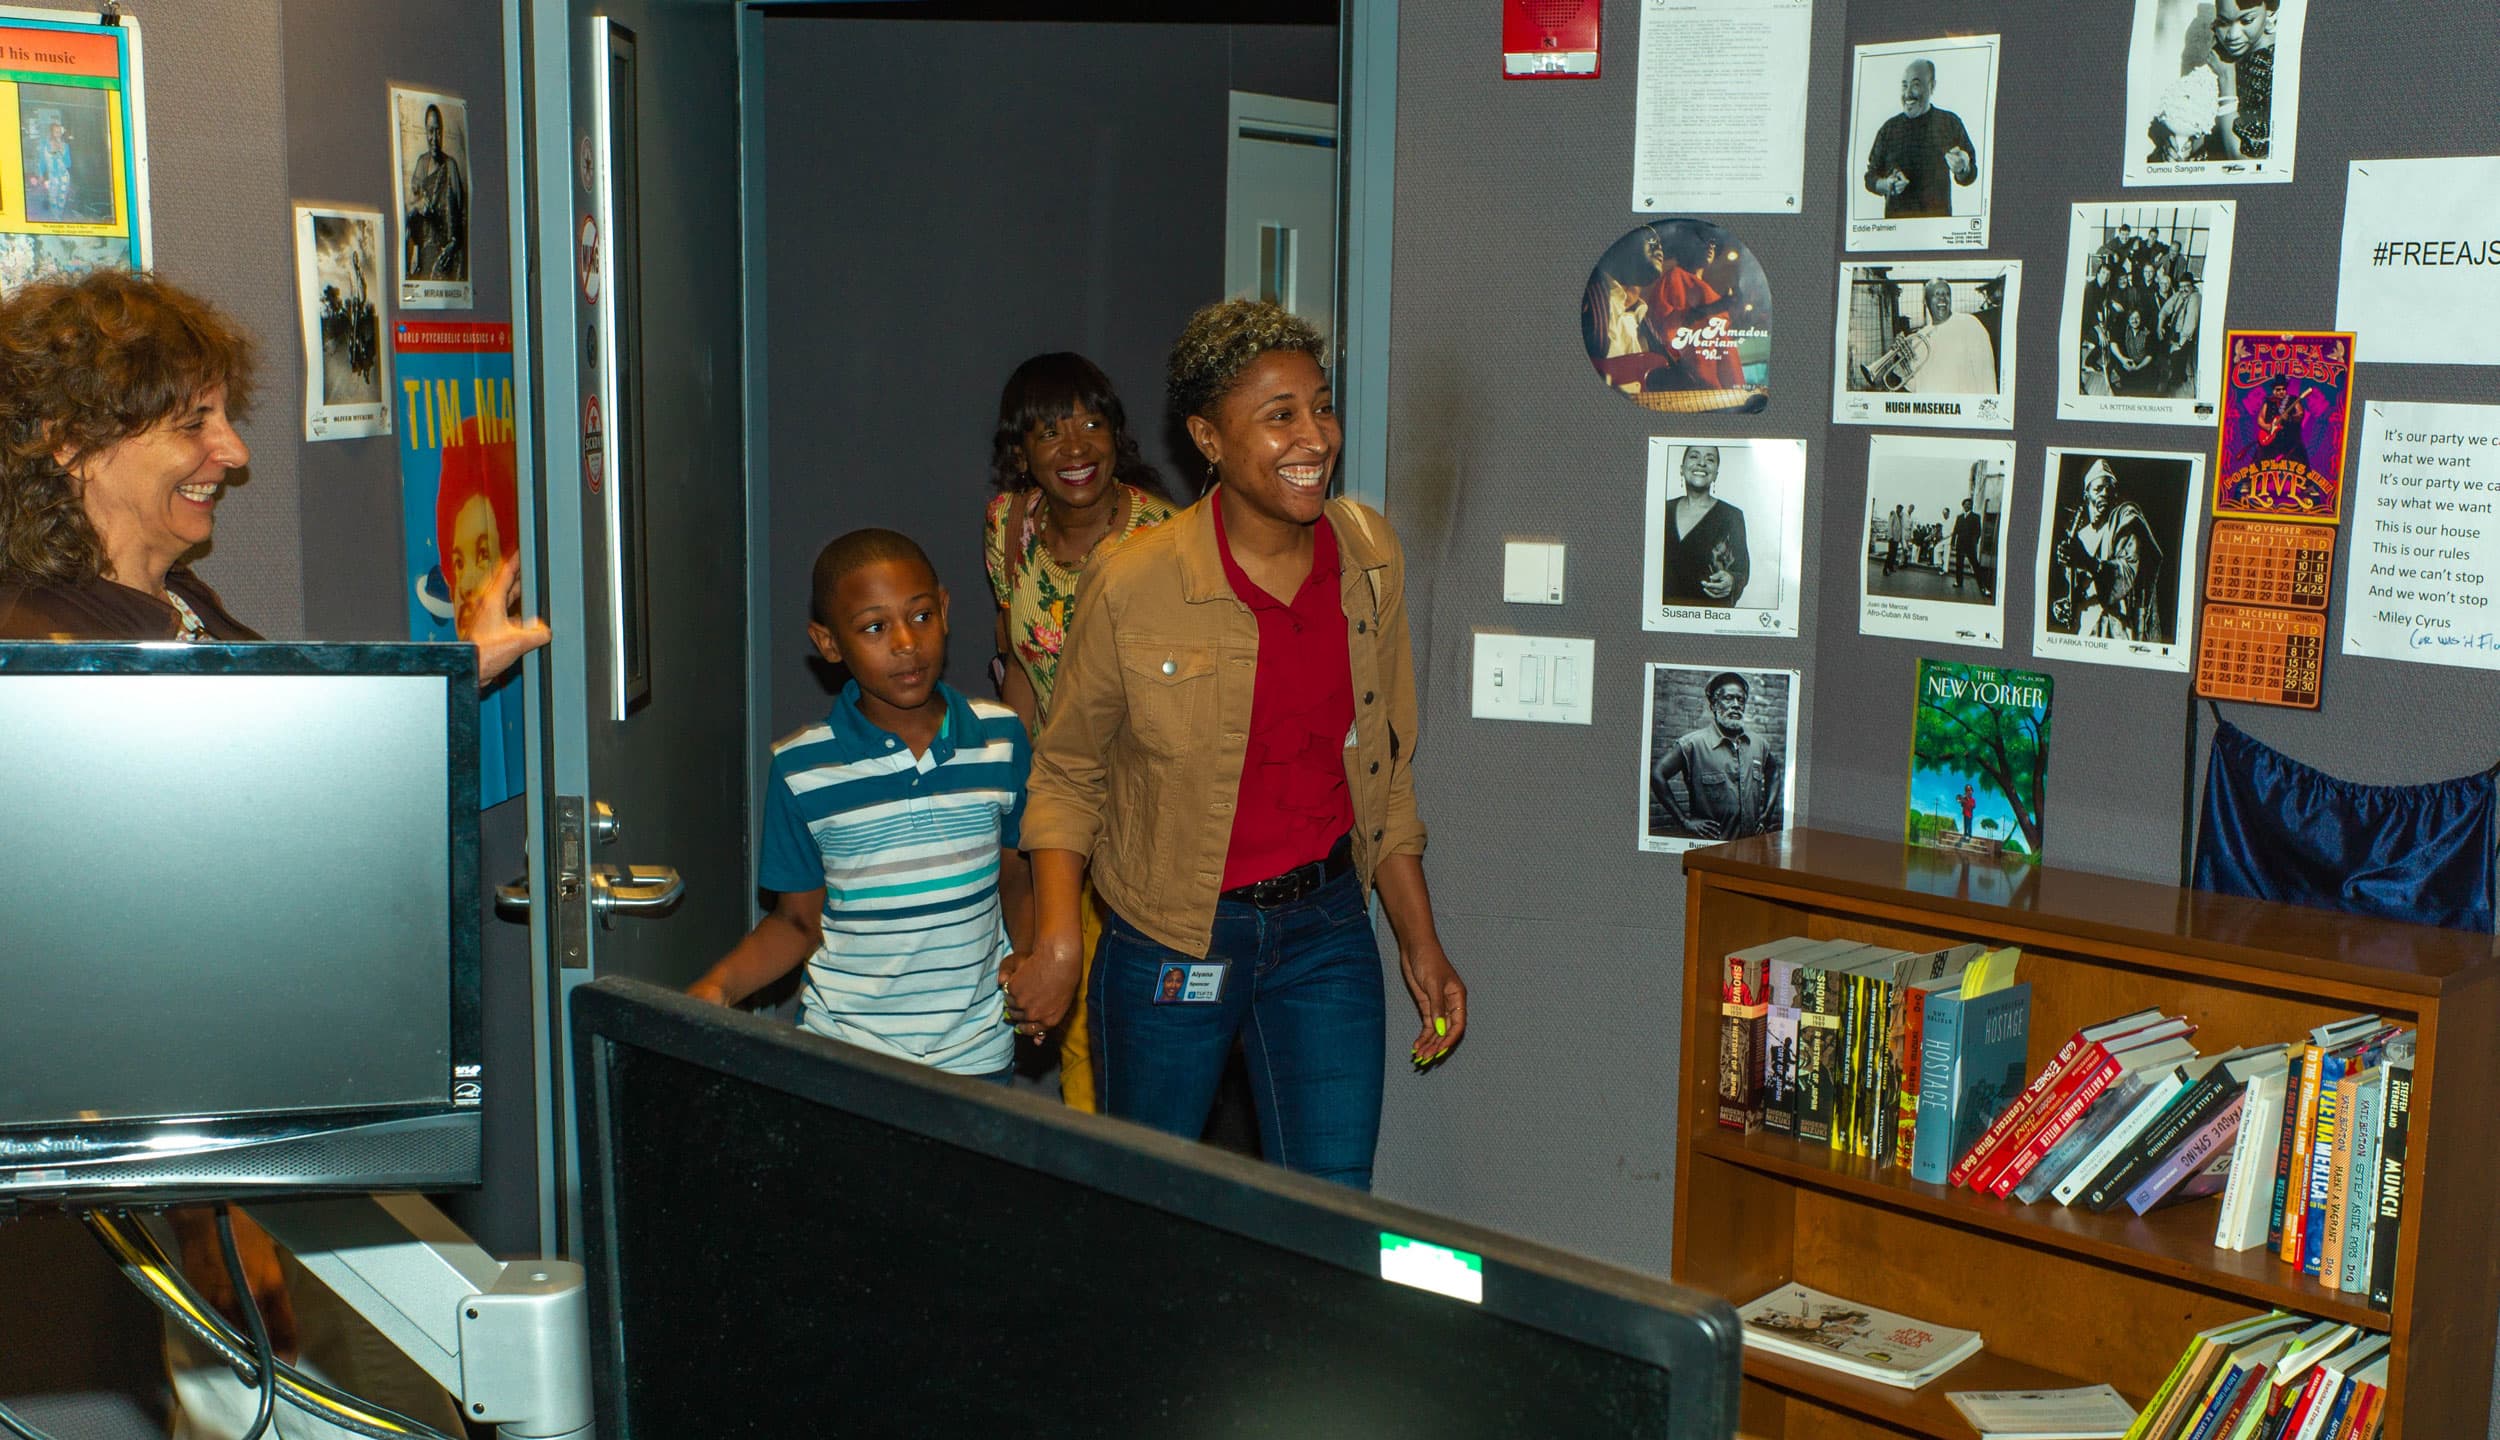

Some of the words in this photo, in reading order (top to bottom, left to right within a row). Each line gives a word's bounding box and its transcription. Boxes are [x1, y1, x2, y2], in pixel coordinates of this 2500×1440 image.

[10, 47, 30, 60] his
[35, 50, 76, 65] music
[2147, 166, 2172, 174] Oumou
[2174, 165, 2205, 174] Sangare
[1853, 224, 1871, 233] Eddie
[1872, 223, 1897, 232] Palmieri
[463, 332, 489, 344] CLASSICS
[1672, 327, 1738, 350] Mariam
[1701, 317, 1768, 339] Amadou
[403, 379, 463, 450] TIM
[1885, 401, 1911, 414] HUGH
[1912, 402, 1961, 415] MASEKELA
[2406, 433, 2427, 442] our
[2430, 434, 2464, 446] party
[2468, 436, 2487, 445] we
[2382, 452, 2412, 464] what
[2416, 456, 2434, 465] we
[2438, 457, 2471, 467] want
[2224, 463, 2259, 489] POPA
[2261, 460, 2306, 475] PLAYS
[2402, 477, 2422, 486] our
[2426, 478, 2459, 491] party
[2464, 481, 2483, 490] we
[2248, 471, 2313, 509] LIVE
[2377, 497, 2397, 509] say
[2401, 497, 2431, 509] what
[2435, 502, 2454, 511] we
[2458, 503, 2492, 513] want
[2247, 524, 2301, 535] NOVEMBER
[2376, 520, 2399, 533] This
[2403, 522, 2412, 533] is
[2415, 525, 2437, 535] our
[2441, 525, 2480, 538] house
[2284, 549, 2290, 558] 2
[2301, 550, 2308, 559] 3
[2317, 552, 2324, 560] 4
[2373, 542, 2397, 555] This
[2401, 544, 2410, 556] is
[2413, 547, 2435, 557] our
[2438, 548, 2470, 560] rules
[2217, 555, 2223, 563] 5
[2233, 557, 2239, 565] 6
[2248, 557, 2255, 566] 7
[2265, 559, 2272, 567] 8
[2282, 560, 2288, 568] 9
[2298, 562, 2308, 570] 10
[2317, 563, 2323, 571] 11
[2214, 566, 2223, 574] 12
[2231, 567, 2240, 576] 13
[2247, 569, 2256, 577] 14
[2264, 570, 2273, 579] 15
[2280, 572, 2290, 580] 16
[2296, 573, 2306, 581] 17
[2314, 574, 2324, 583] 18
[2370, 564, 2395, 576] And
[2398, 568, 2417, 578] we
[2455, 573, 2484, 585] stop
[2214, 577, 2223, 585] 19
[2228, 578, 2239, 587] 20
[2295, 584, 2308, 593] 24
[2310, 585, 2323, 594] 25
[2369, 585, 2393, 598] And
[2396, 590, 2415, 600] we
[2459, 595, 2488, 608] stop
[1662, 608, 1701, 619] Susana
[1704, 610, 1731, 620] Baca
[2239, 609, 2289, 620] DECEMBER
[2373, 611, 2412, 627] -Miley
[2415, 614, 2451, 629] Cyrus
[2060, 638, 2081, 646] FARKA
[2084, 641, 2108, 649] TOURE
[1976, 671, 1996, 681] THE
[1929, 676, 1968, 698] NEW
[1971, 681, 2042, 709] YORKER
[1733, 965, 1742, 1003] SHOWA
[1816, 975, 1826, 1013] SHOWA
[1985, 1007, 2024, 1045] HOSTAGE
[1731, 1026, 1739, 1056] HISTORY
[1813, 1038, 1821, 1070] HISTORY
[2306, 1049, 2318, 1061] TO
[1731, 1060, 1737, 1070] OF
[1922, 1038, 1950, 1111] HOSTAGE
[2101, 1067, 2114, 1080] MY
[2305, 1062, 2317, 1081] THE
[1813, 1073, 1820, 1083] OF
[2082, 1076, 2104, 1099] BATTLE
[2215, 1083, 2223, 1094] HE
[1811, 1085, 1819, 1111] JAPAN
[2198, 1092, 2214, 1111] CALLS
[2287, 1091, 2296, 1115] SOULS
[2339, 1095, 2350, 1115] KATE
[2389, 1080, 2401, 1128] KVERNELAND
[2400, 1082, 2409, 1112] STEFFEN
[1993, 1102, 2025, 1136] Contract
[2059, 1098, 2084, 1128] AGAINST
[2187, 1109, 2197, 1120] ME
[2361, 1100, 2370, 1117] KATE
[2179, 1118, 2188, 1129] BY
[2338, 1116, 2349, 1151] BEATON
[1975, 1135, 1996, 1156] With
[2040, 1123, 2063, 1148] HITLER
[2147, 1126, 2179, 1158] LIGHTNING
[2282, 1124, 2292, 1151] YELLOW
[2296, 1130, 2306, 1155] LAND
[2358, 1118, 2369, 1157] BEATON
[2180, 1134, 2212, 1167] SPRING
[1961, 1154, 1977, 1172] God
[2279, 1153, 2288, 1175] FOLK
[2275, 1177, 2286, 1205] WESLEY
[2353, 1163, 2364, 1200] STEP
[2381, 1158, 2402, 1218] MUNCH
[2272, 1206, 2281, 1228] YANG
[2328, 1203, 2342, 1243] VAGRANT
[2349, 1237, 2359, 1258] POPS
